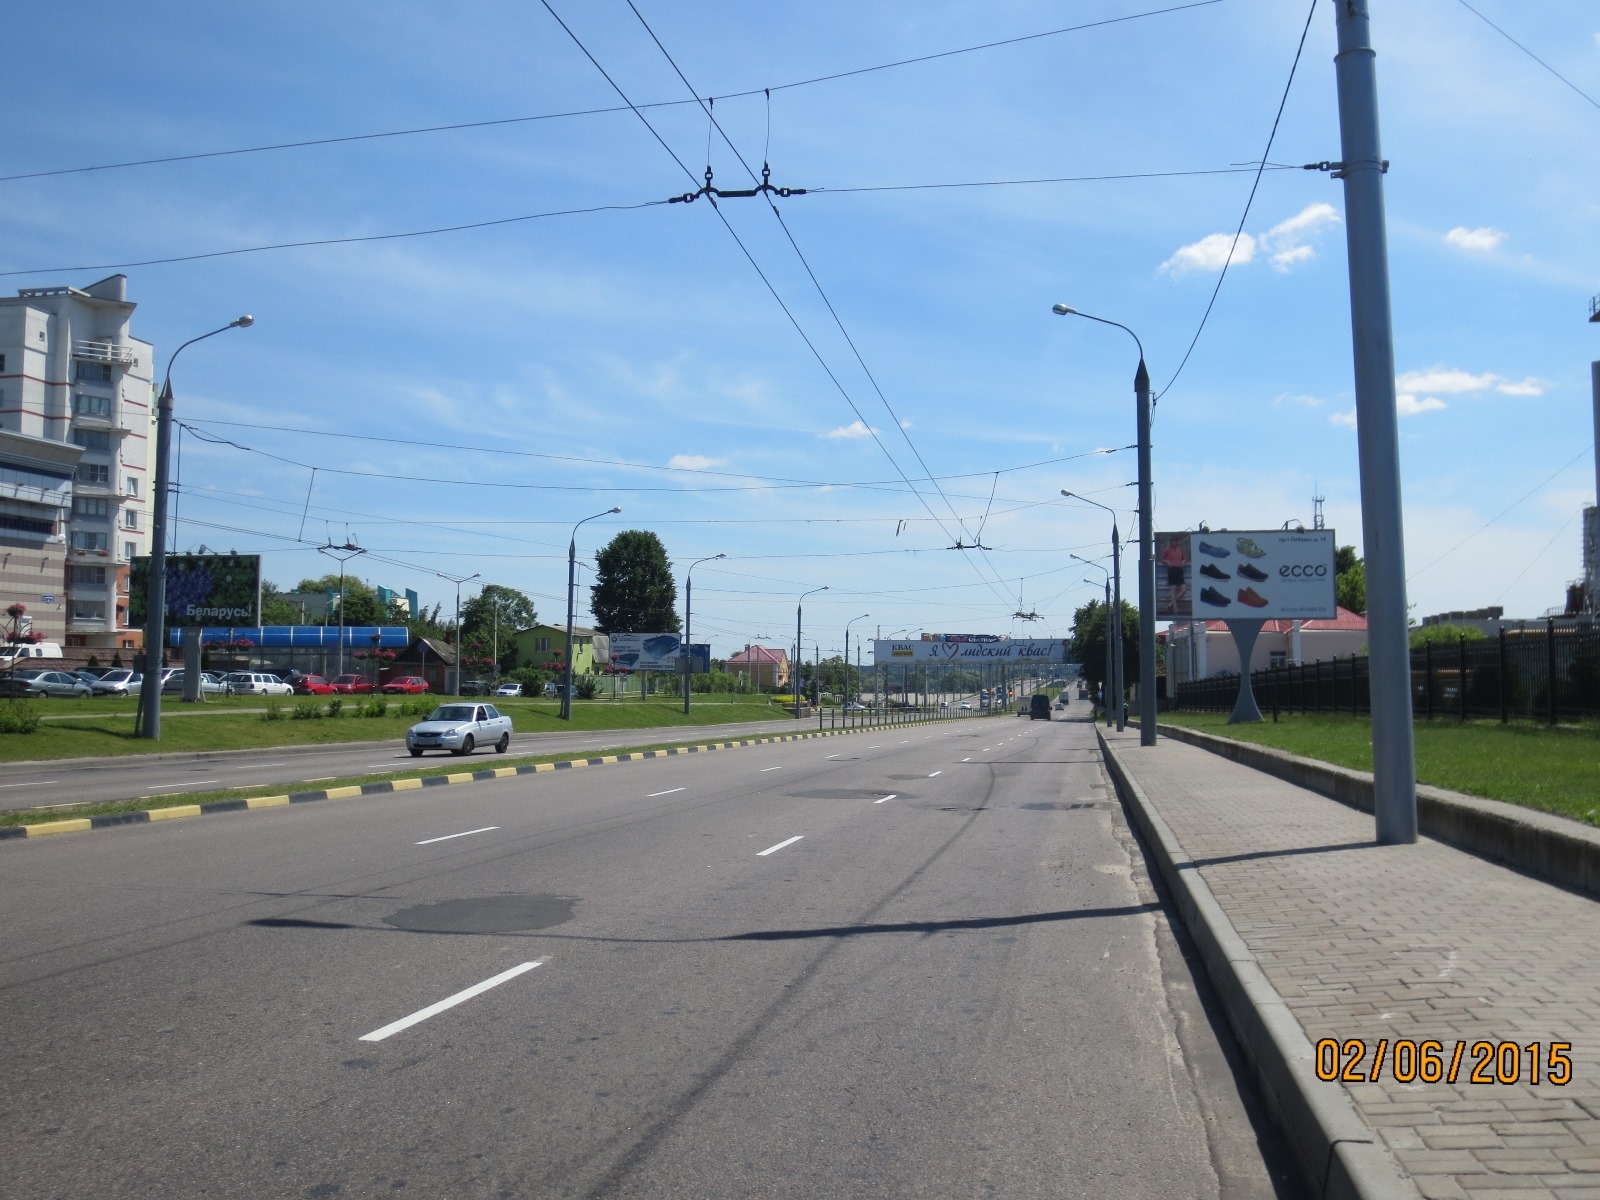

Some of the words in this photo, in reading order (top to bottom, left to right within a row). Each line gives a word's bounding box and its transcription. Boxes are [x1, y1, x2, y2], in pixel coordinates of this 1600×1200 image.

[1279, 565, 1327, 577] ecco
[186, 603, 252, 619] Беларусь!
[929, 644, 939, 656] Я
[960, 643, 1012, 657] лидский
[1017, 642, 1054, 657] квас!
